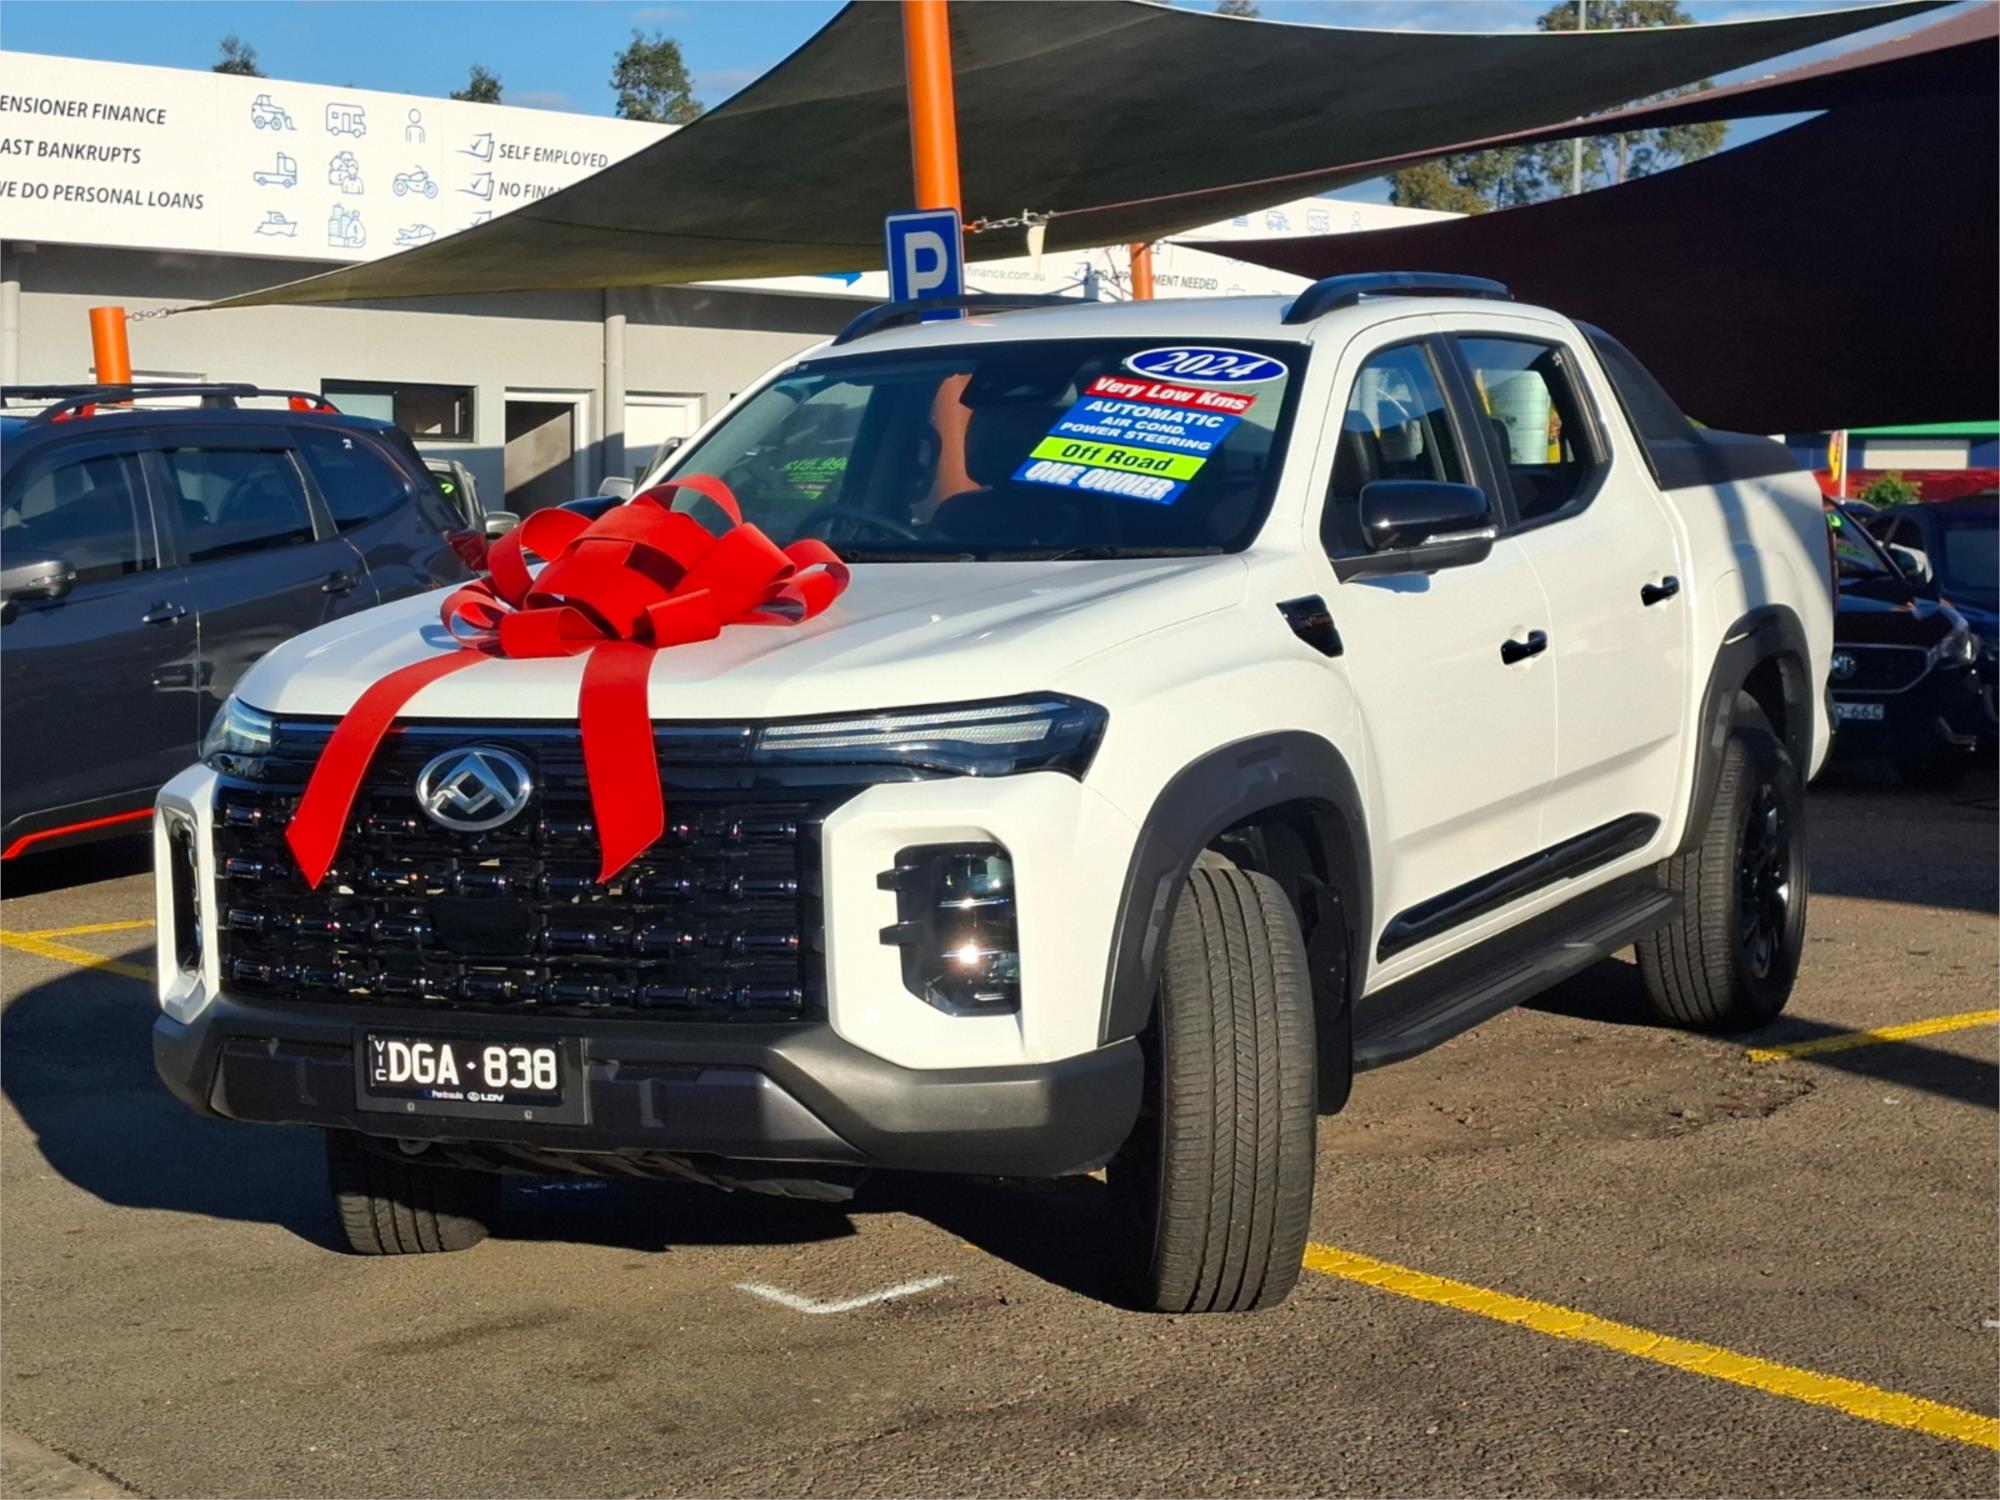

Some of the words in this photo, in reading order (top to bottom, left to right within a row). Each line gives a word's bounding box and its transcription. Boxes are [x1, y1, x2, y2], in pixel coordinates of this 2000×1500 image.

[0, 95, 88, 118] ENSIONER
[92, 103, 167, 125] FINANCE
[0, 138, 34, 156] AST
[37, 140, 141, 164] BANKRUPTS
[499, 143, 531, 160] SELF
[533, 147, 608, 168] EMPLOYED
[21, 182, 49, 199] DO
[53, 184, 144, 206] PERSONAL
[148, 191, 204, 210] LOANS
[499, 182, 521, 197] NO
[905, 230, 948, 300] P
[1181, 274, 1218, 290] NEEDED
[1147, 351, 1268, 379] 2024
[1095, 378, 1143, 398] Very
[1150, 385, 1191, 403] Low
[1196, 391, 1249, 411] Kms
[1085, 401, 1225, 429] AUTOMATIC
[1103, 416, 1130, 427] AIR
[1135, 420, 1186, 436] COND.
[1060, 422, 1121, 438] POWER
[1124, 433, 1213, 452] STEERING
[1061, 443, 1104, 461] Off
[1106, 450, 1175, 472] Road
[1024, 462, 1086, 486] ONE
[1079, 469, 1176, 501] OWNER
[374, 1041, 387, 1081] VIC
[389, 1041, 460, 1086] DGA
[484, 1046, 558, 1090] 838
[481, 1094, 505, 1102] LDV
